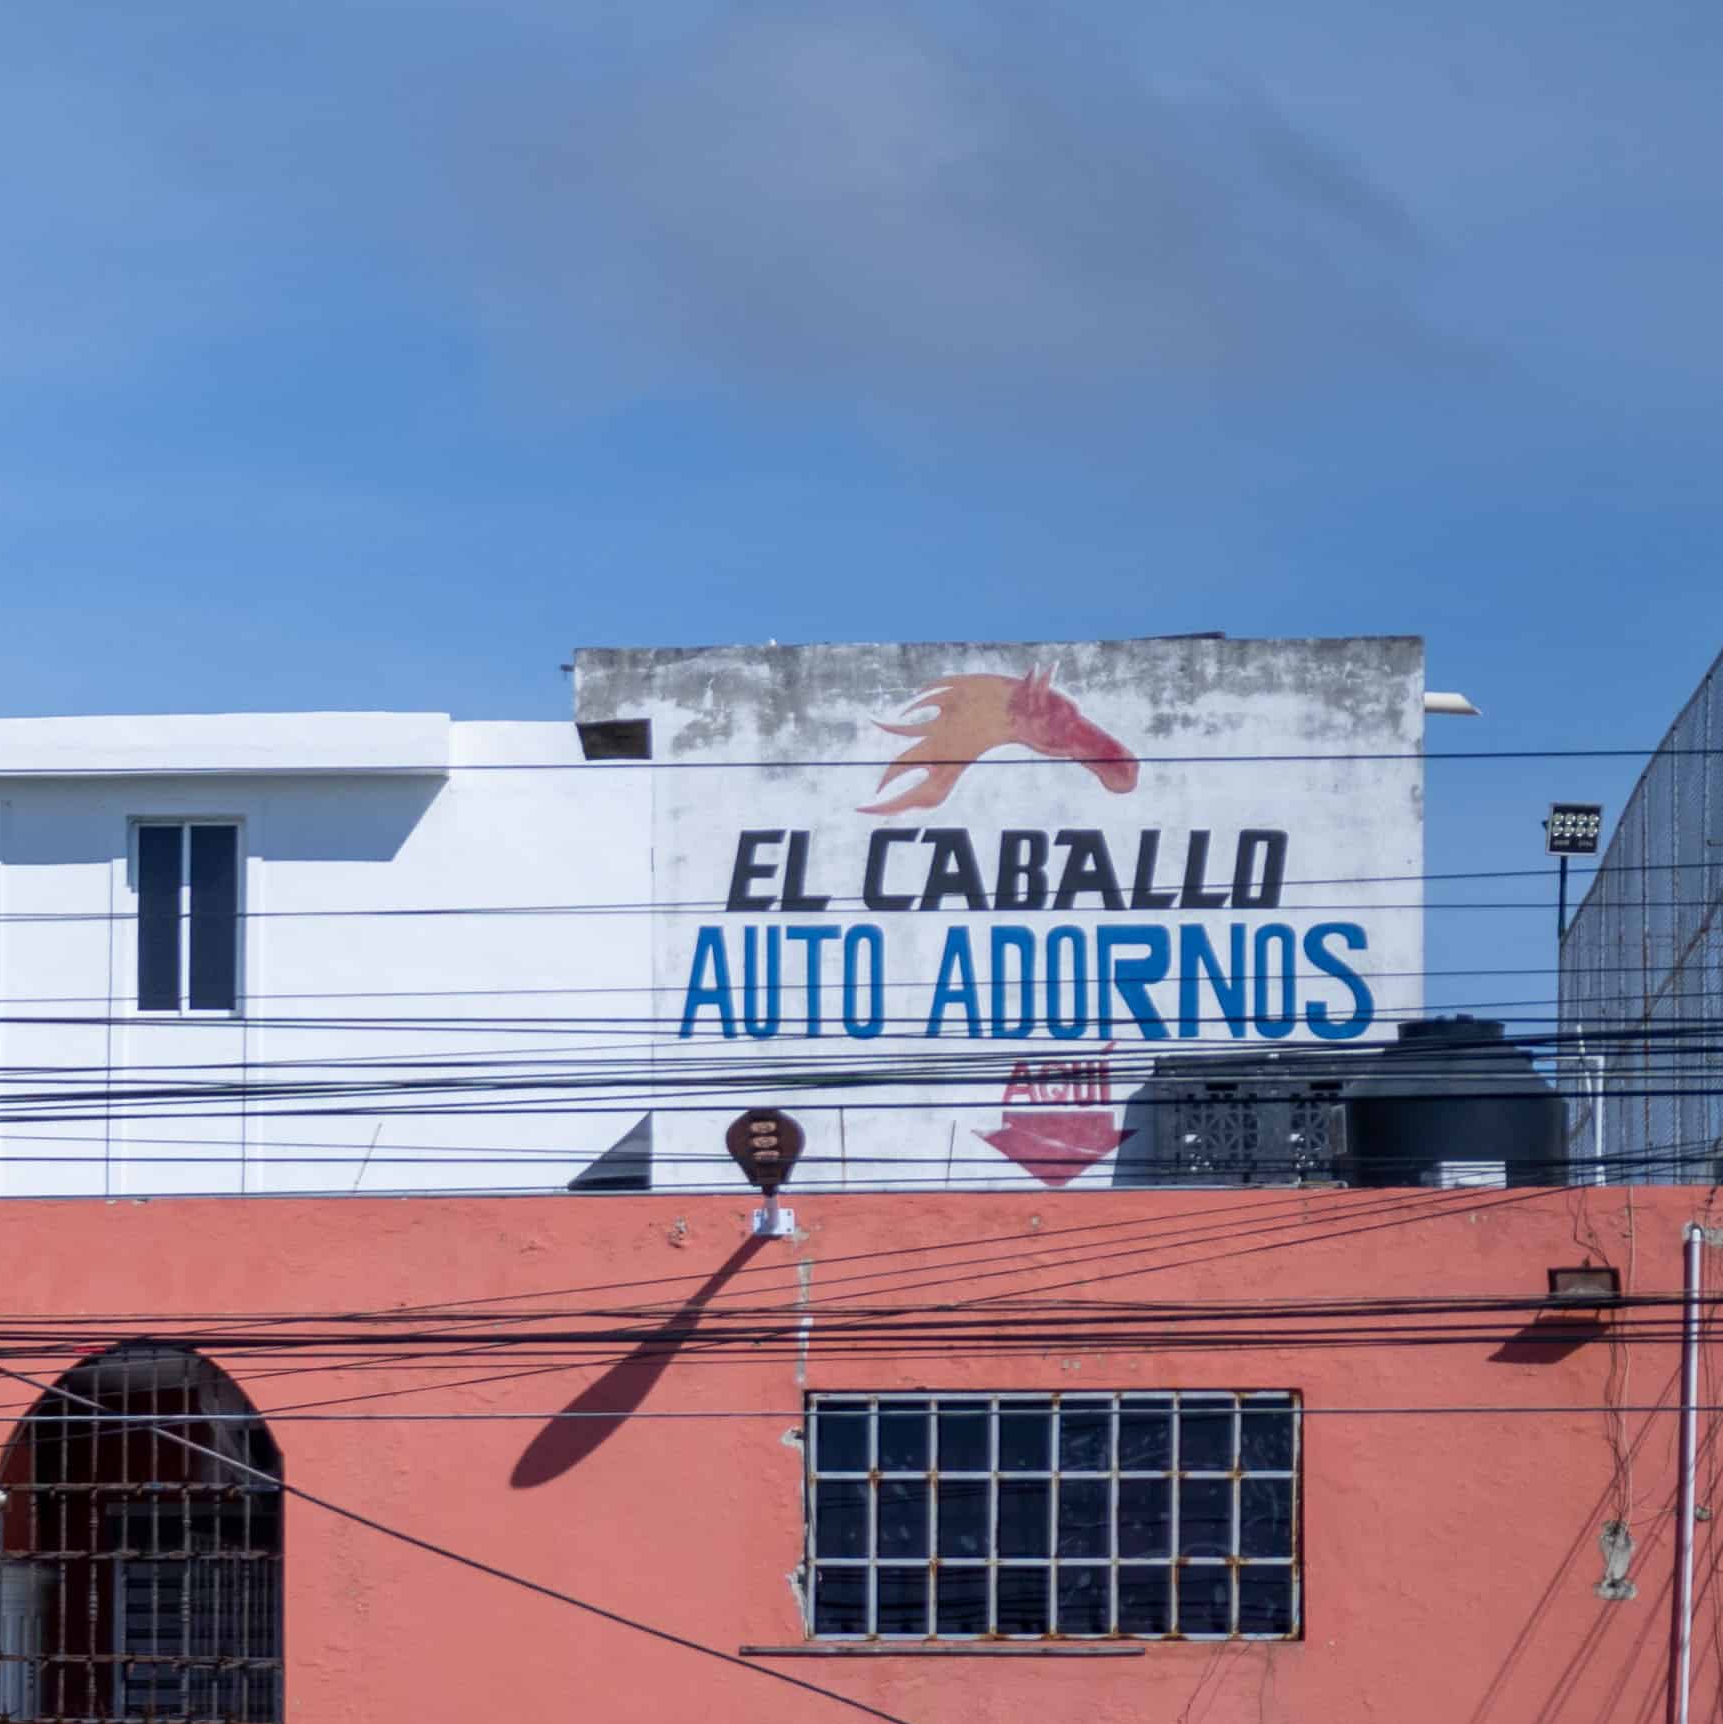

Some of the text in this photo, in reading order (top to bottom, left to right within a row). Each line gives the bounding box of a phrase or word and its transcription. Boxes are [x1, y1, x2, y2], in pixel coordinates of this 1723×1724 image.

[726, 827, 1288, 912] EL CABALLO
[678, 922, 1376, 1041] AUTO ADORNOS
